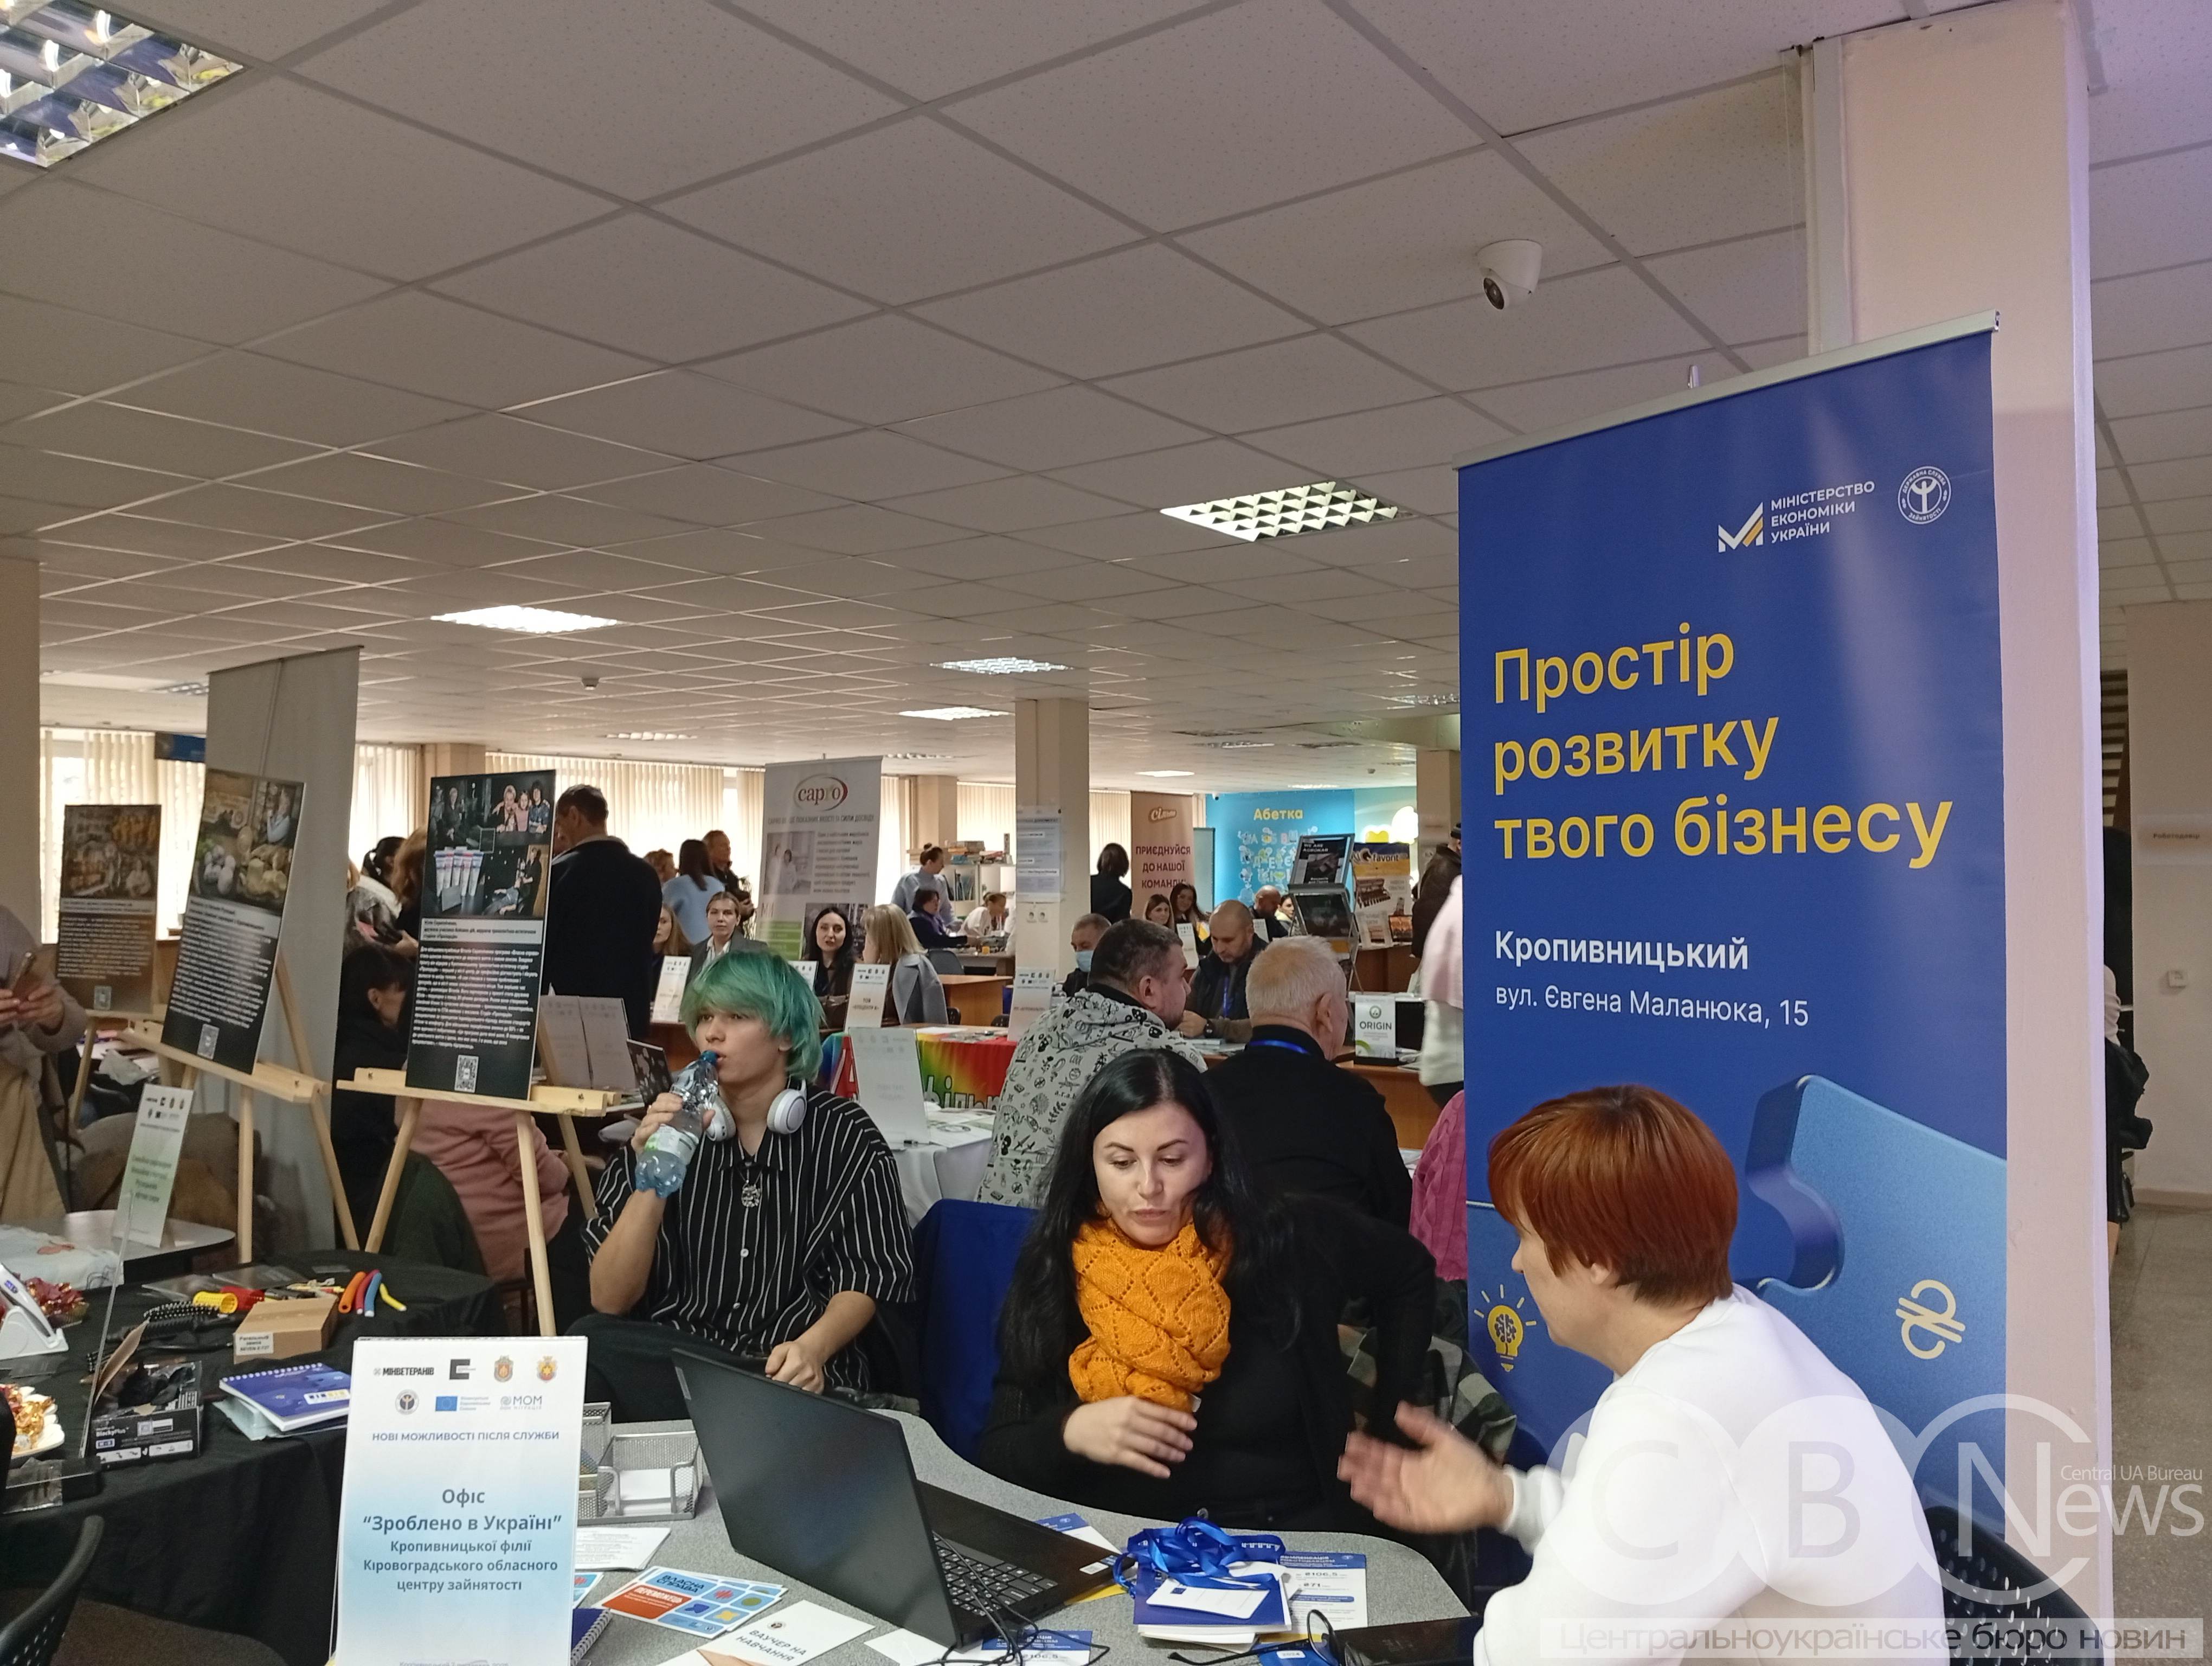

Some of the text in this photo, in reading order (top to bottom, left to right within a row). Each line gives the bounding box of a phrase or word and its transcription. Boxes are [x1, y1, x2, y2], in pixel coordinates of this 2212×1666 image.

[1902, 470, 1946, 494] ДЕРЖАВНА СЛУЖБА
[1771, 480, 1875, 511] МІНІСТЕРСТВО
[1771, 501, 1855, 527] ЕКОНОМІКИ
[1908, 508, 1941, 520] ЗАЙНЯТОСТІ
[1771, 521, 1830, 543] УКРАЇНИ
[1495, 622, 1734, 713] Простір
[1495, 717, 1779, 794] розвитку
[1253, 808, 1303, 821] Абетка
[1495, 793, 1953, 869] твого бізнесу
[1136, 844, 1191, 856] ПРИЄДНУЙСЯ
[1142, 860, 1185, 873] ДО НАШОЇ
[1495, 930, 1748, 973] Кропивницький
[1496, 985, 1809, 1029] вул. Євгена Маланюка, 15
[1359, 1021, 1392, 1030] ORIGIN
[383, 1367, 434, 1376] МІНВЕТЕРАНІВ
[513, 1395, 542, 1405] МОМ
[372, 1432, 560, 1441] НОВІ МОЖЛИВОСТІ ПІСЛЯ СЛУЖБИ
[442, 1488, 485, 1508] Офіс
[468, 1518, 478, 1530] в
[390, 1539, 532, 1555] Кропивницької філії
[363, 1559, 558, 1574] Кіровоградського обласного
[397, 1579, 522, 1593] центру зайнятості
[657, 1578, 699, 1593] СПРАВА
[662, 1575, 705, 1590] ВЛАСНА
[736, 1636, 795, 1662] НАВЧАННЯ
[749, 1630, 807, 1656] ВАУЧЕР НА
